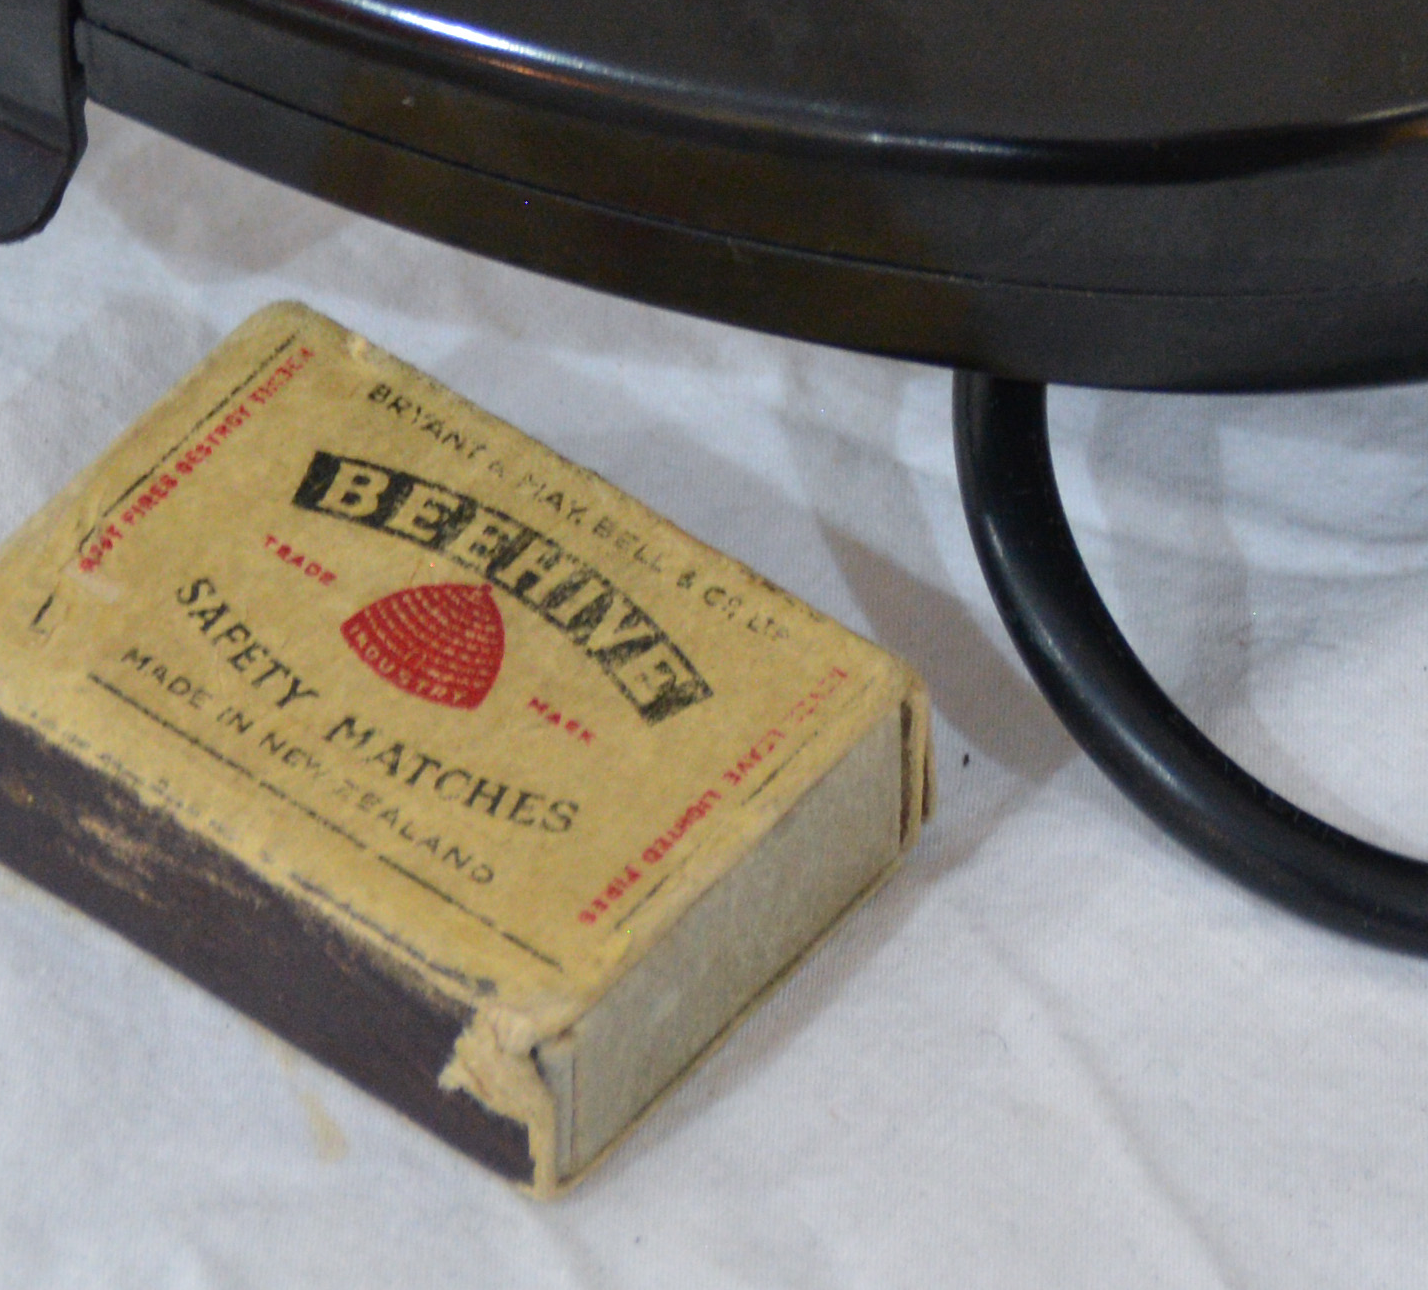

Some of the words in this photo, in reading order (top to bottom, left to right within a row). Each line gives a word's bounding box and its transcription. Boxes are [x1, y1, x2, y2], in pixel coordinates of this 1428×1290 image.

[368, 382, 487, 459] BRYANT
[263, 534, 337, 587] TRADE
[312, 457, 694, 709] BEEHIVE
[349, 623, 468, 704] INDUSTRY
[176, 576, 319, 710] SAFETY
[323, 715, 580, 833] MATCHES
[528, 696, 596, 745] MARK
[121, 647, 215, 711] MADE
[216, 706, 254, 734] IN
[259, 730, 329, 780] NEW
[331, 778, 495, 884] ZEALAND
